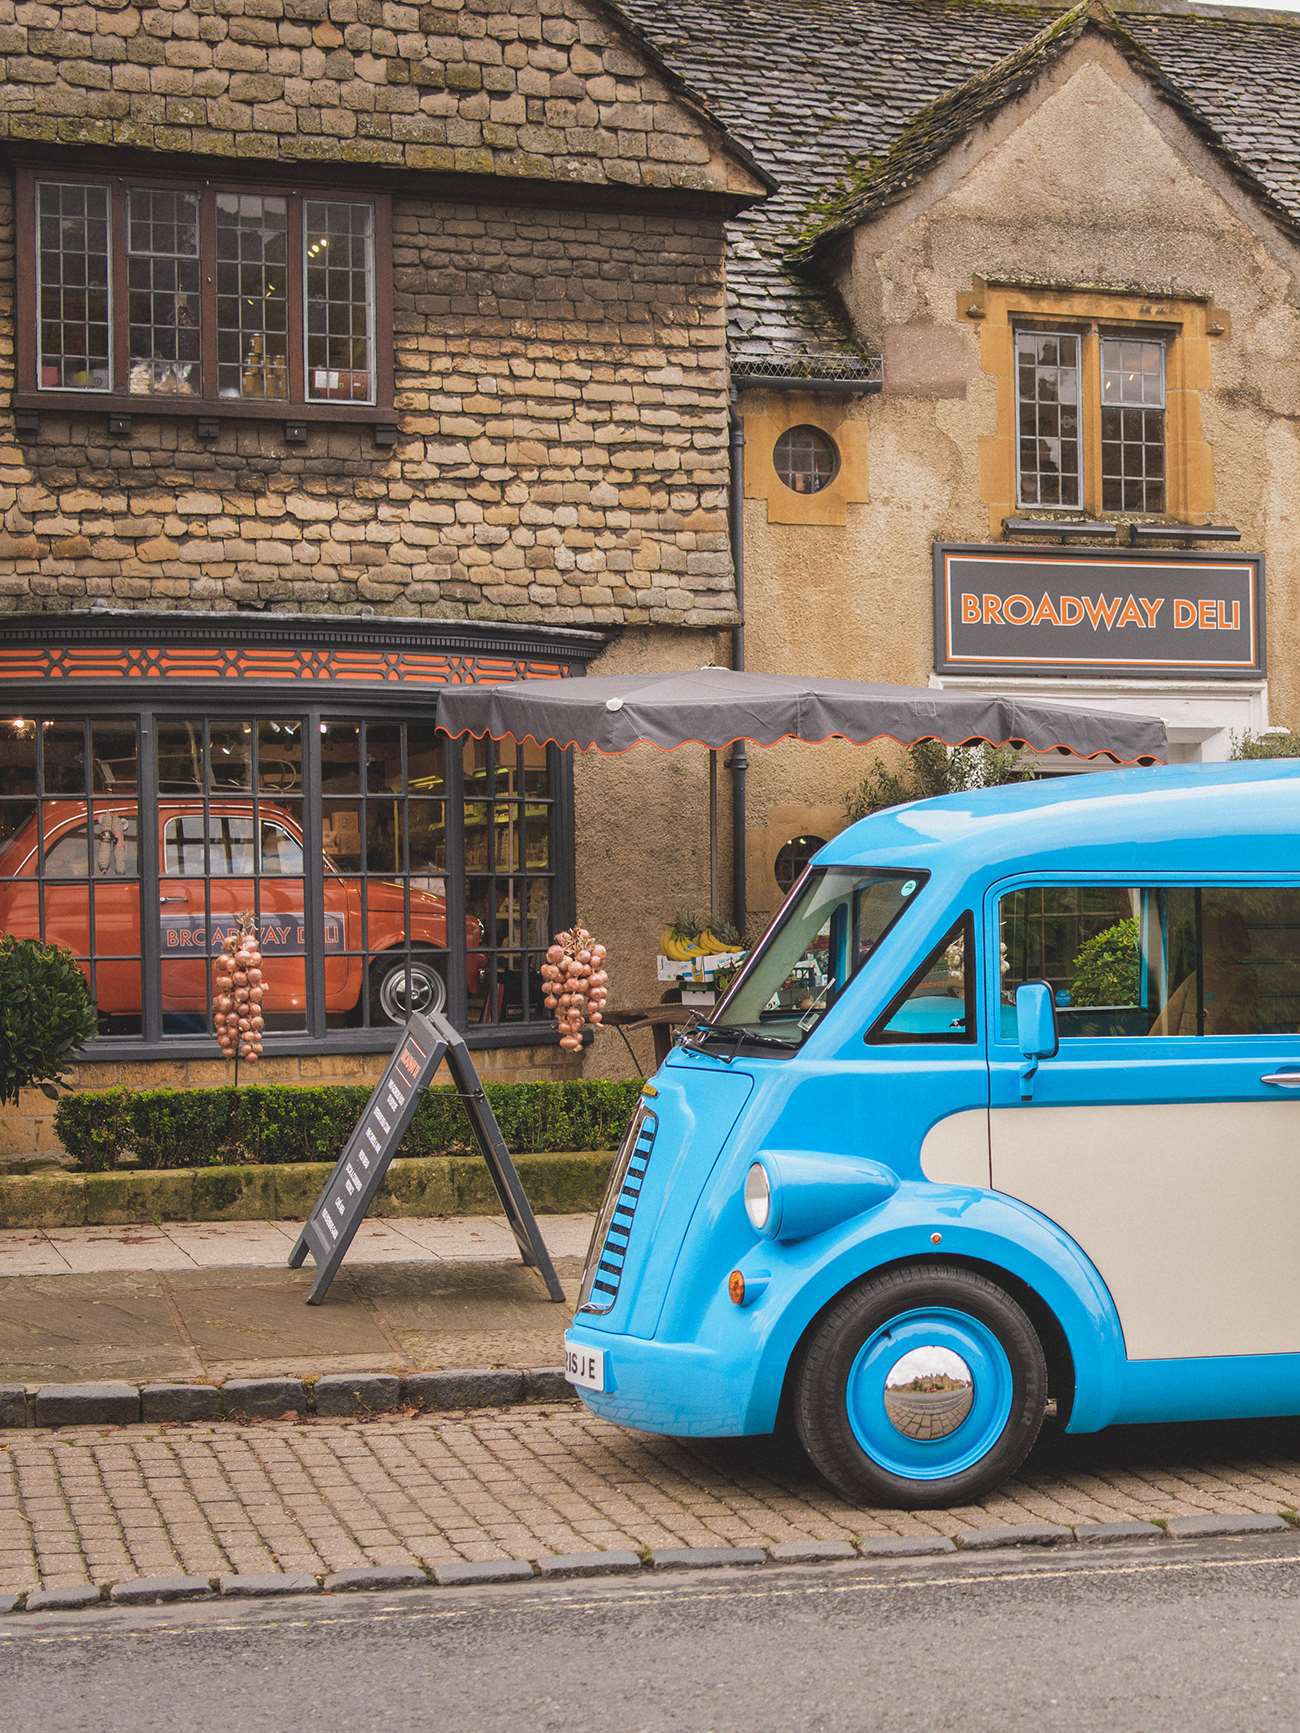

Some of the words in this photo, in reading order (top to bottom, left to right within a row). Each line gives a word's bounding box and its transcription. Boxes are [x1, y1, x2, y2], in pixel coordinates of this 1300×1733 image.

[961, 591, 1165, 631] BROADWAY
[1173, 598, 1241, 631] DELI
[296, 926, 339, 944] DLI
